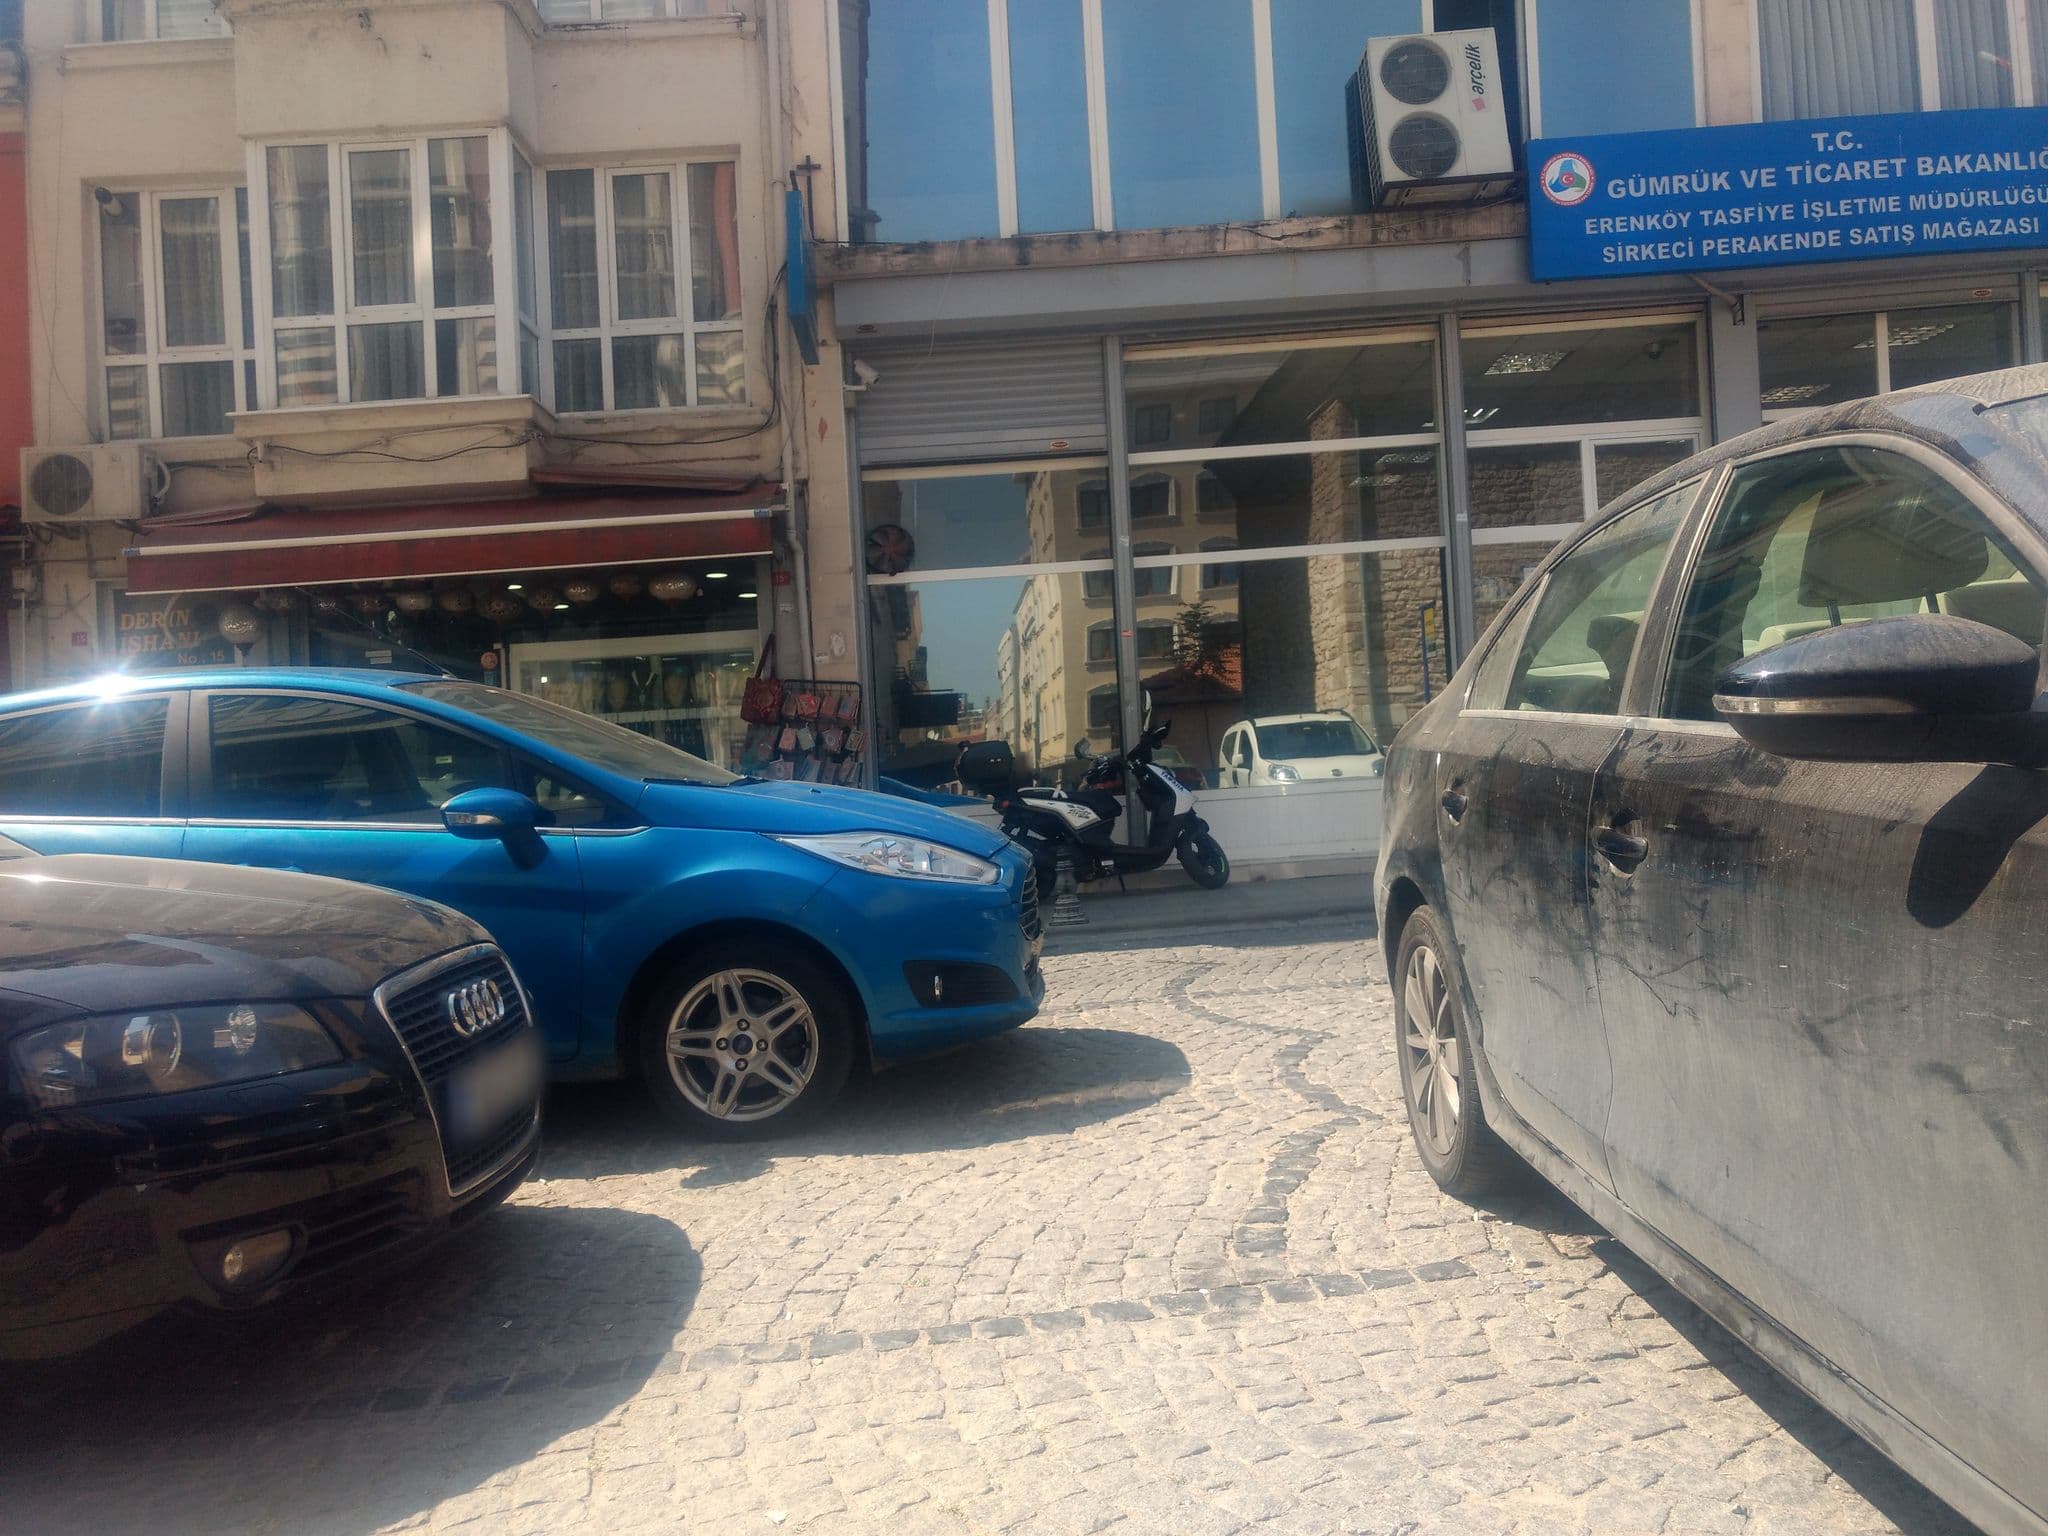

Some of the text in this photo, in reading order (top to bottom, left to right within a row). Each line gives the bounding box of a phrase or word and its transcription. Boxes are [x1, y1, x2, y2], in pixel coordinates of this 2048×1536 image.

[1465, 43, 1485, 95] arçelik
[1811, 131, 1863, 152] T.C.
[1607, 168, 1732, 199] GÜMRÜK
[1739, 167, 1777, 189] VE
[1786, 157, 1907, 185] TİCARET
[1585, 209, 1691, 235] ERENKÖY
[1700, 202, 1794, 227] TASFİYE
[1802, 195, 1902, 223] İŞLETME
[1602, 216, 2040, 264] SİRKECİ PERAKENDE SATIŞ MAĞAZASI
